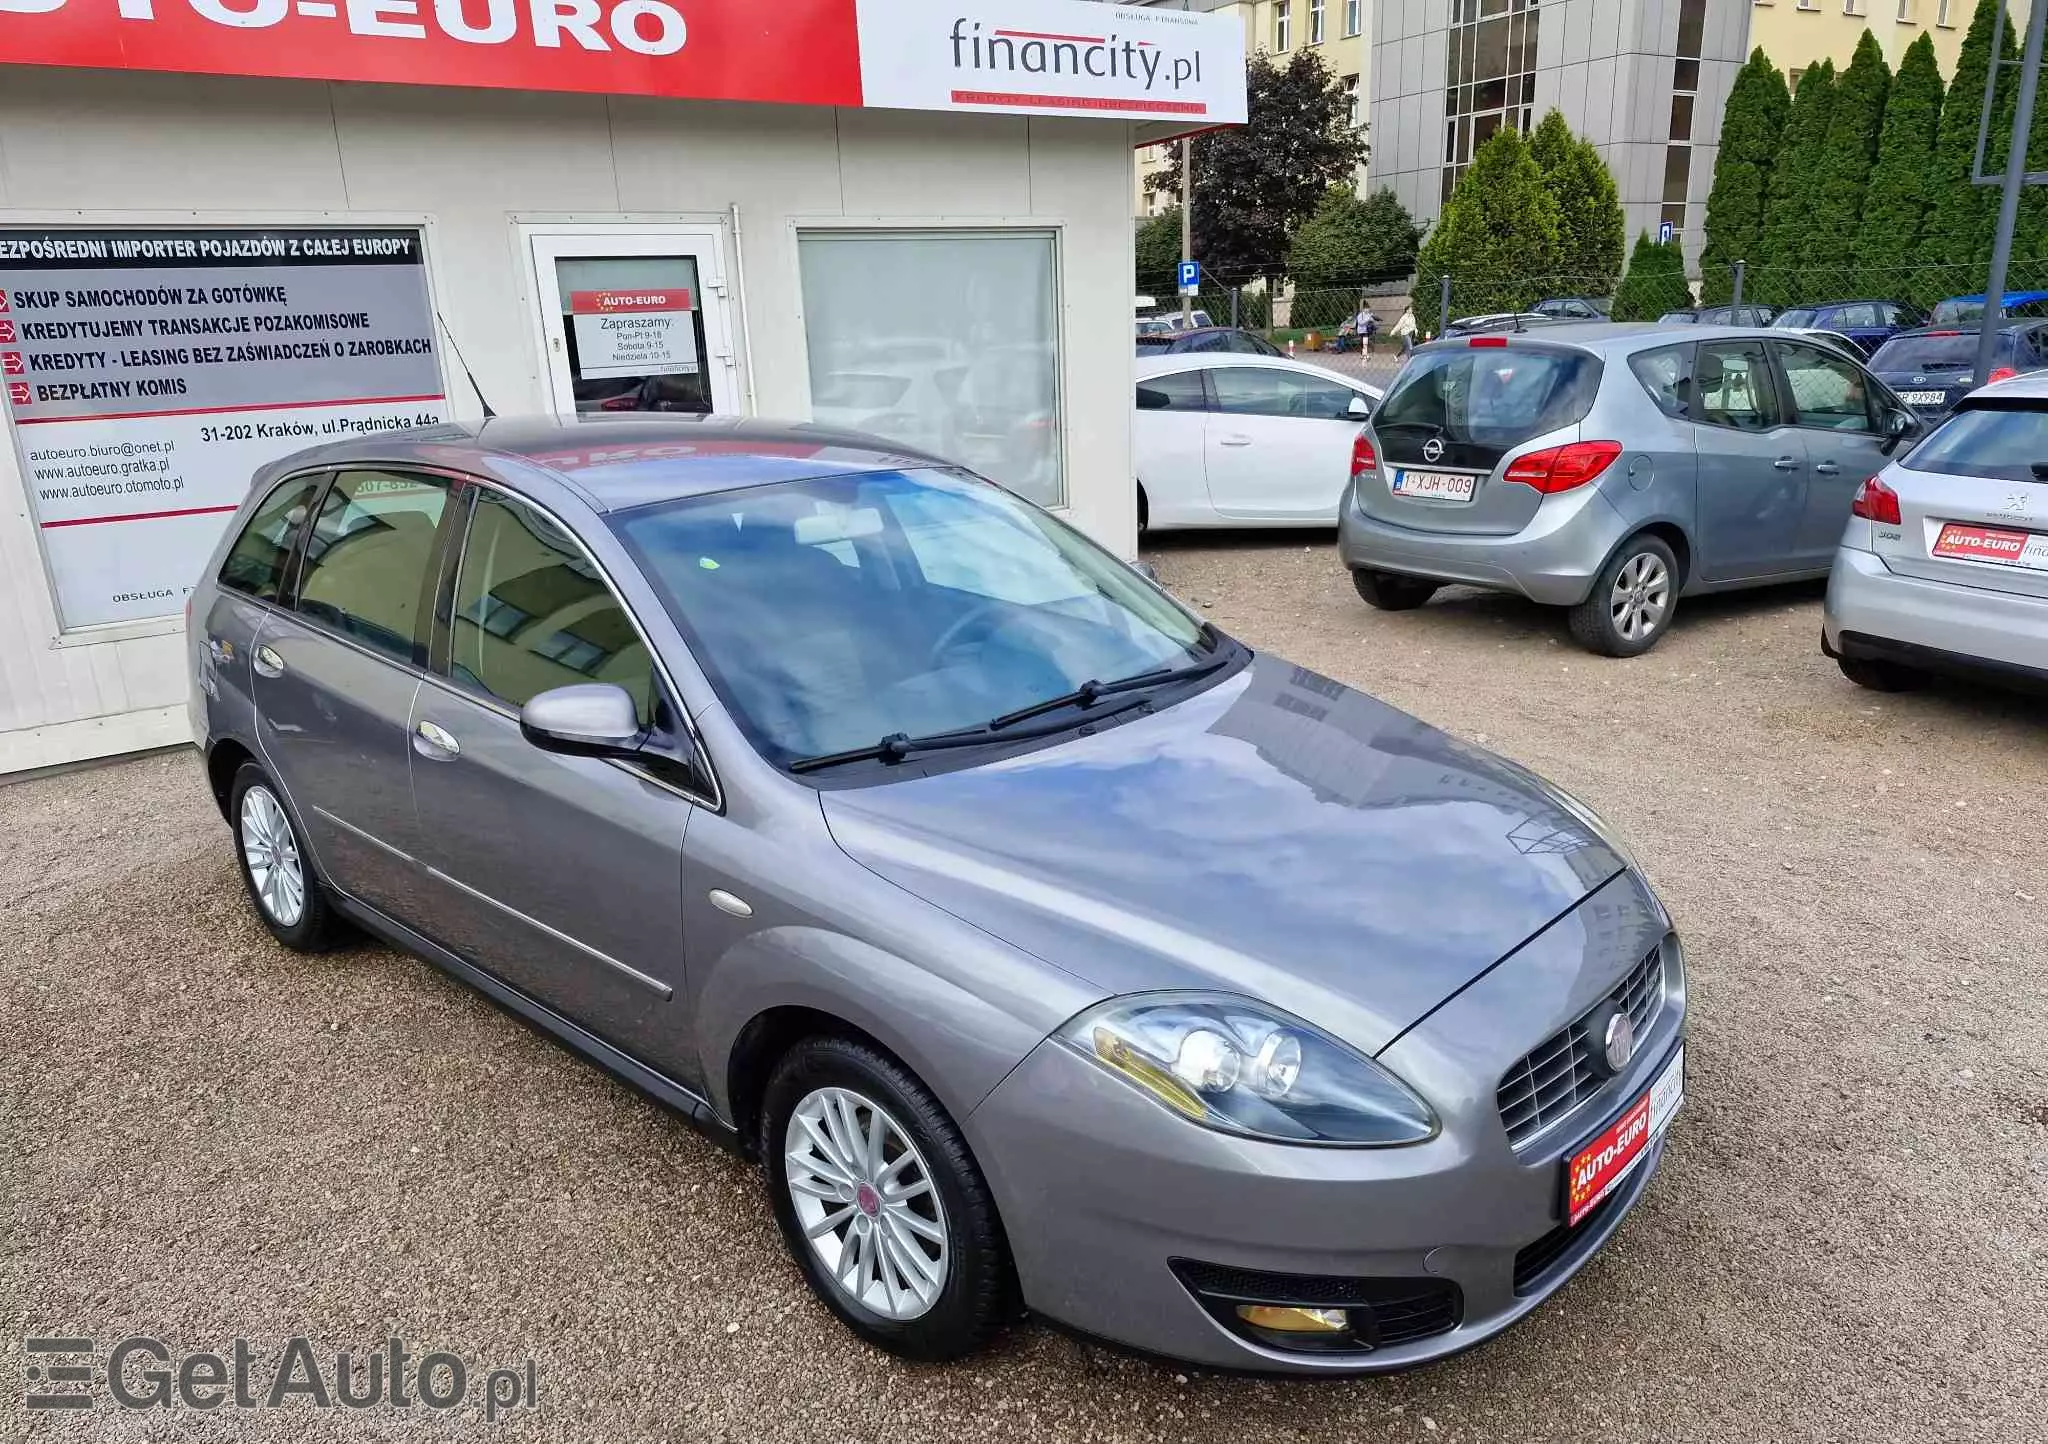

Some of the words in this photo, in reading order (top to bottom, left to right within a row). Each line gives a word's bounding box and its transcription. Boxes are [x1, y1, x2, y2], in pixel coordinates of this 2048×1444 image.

[949, 18, 1200, 90] financity.pl
[111, 239, 198, 258] IMPORTER
[200, 235, 288, 257] POJAZDÓW
[290, 239, 301, 256] Z
[303, 239, 350, 256] CAŁEJ
[352, 238, 410, 256] EUROPY
[14, 290, 60, 309] SKUP
[66, 285, 183, 308] SAMOCHODÓW
[186, 289, 209, 304] ZA
[212, 284, 288, 306] GOTÓWKĘ
[603, 296, 667, 306] AUTO-EURO
[22, 317, 144, 340] KREDYTUJEMY
[148, 315, 250, 335] TRANSAKCJE
[255, 312, 370, 332] POZAKOMISOWE
[29, 351, 107, 371] KREDYTY
[121, 347, 189, 367] LEASING
[194, 345, 224, 363] BEZ
[226, 338, 332, 361] ZAŚWIADCZEŃ
[334, 341, 345, 357] O
[348, 338, 431, 357] ZAROBKACH
[612, 352, 648, 361] Niedziela
[617, 342, 645, 351] Sobota
[36, 380, 131, 402] BEZPŁATNY
[136, 378, 187, 396] KOMIS
[201, 425, 253, 442] 31-202
[257, 419, 318, 439] Kraków,
[322, 415, 411, 435] ul.Prądnicka
[415, 413, 439, 427] 44a
[30, 440, 175, 462] autoeuro.biuro@onet.pl
[34, 458, 170, 481] www.autoeuro.gratka.pl
[39, 476, 185, 501] www.autoeuro.otomoto.pl
[1946, 534, 2021, 551] AUTO-EURO
[112, 589, 174, 603] OBSŁUGA
[1577, 1111, 1647, 1191] AUTO-EURO
